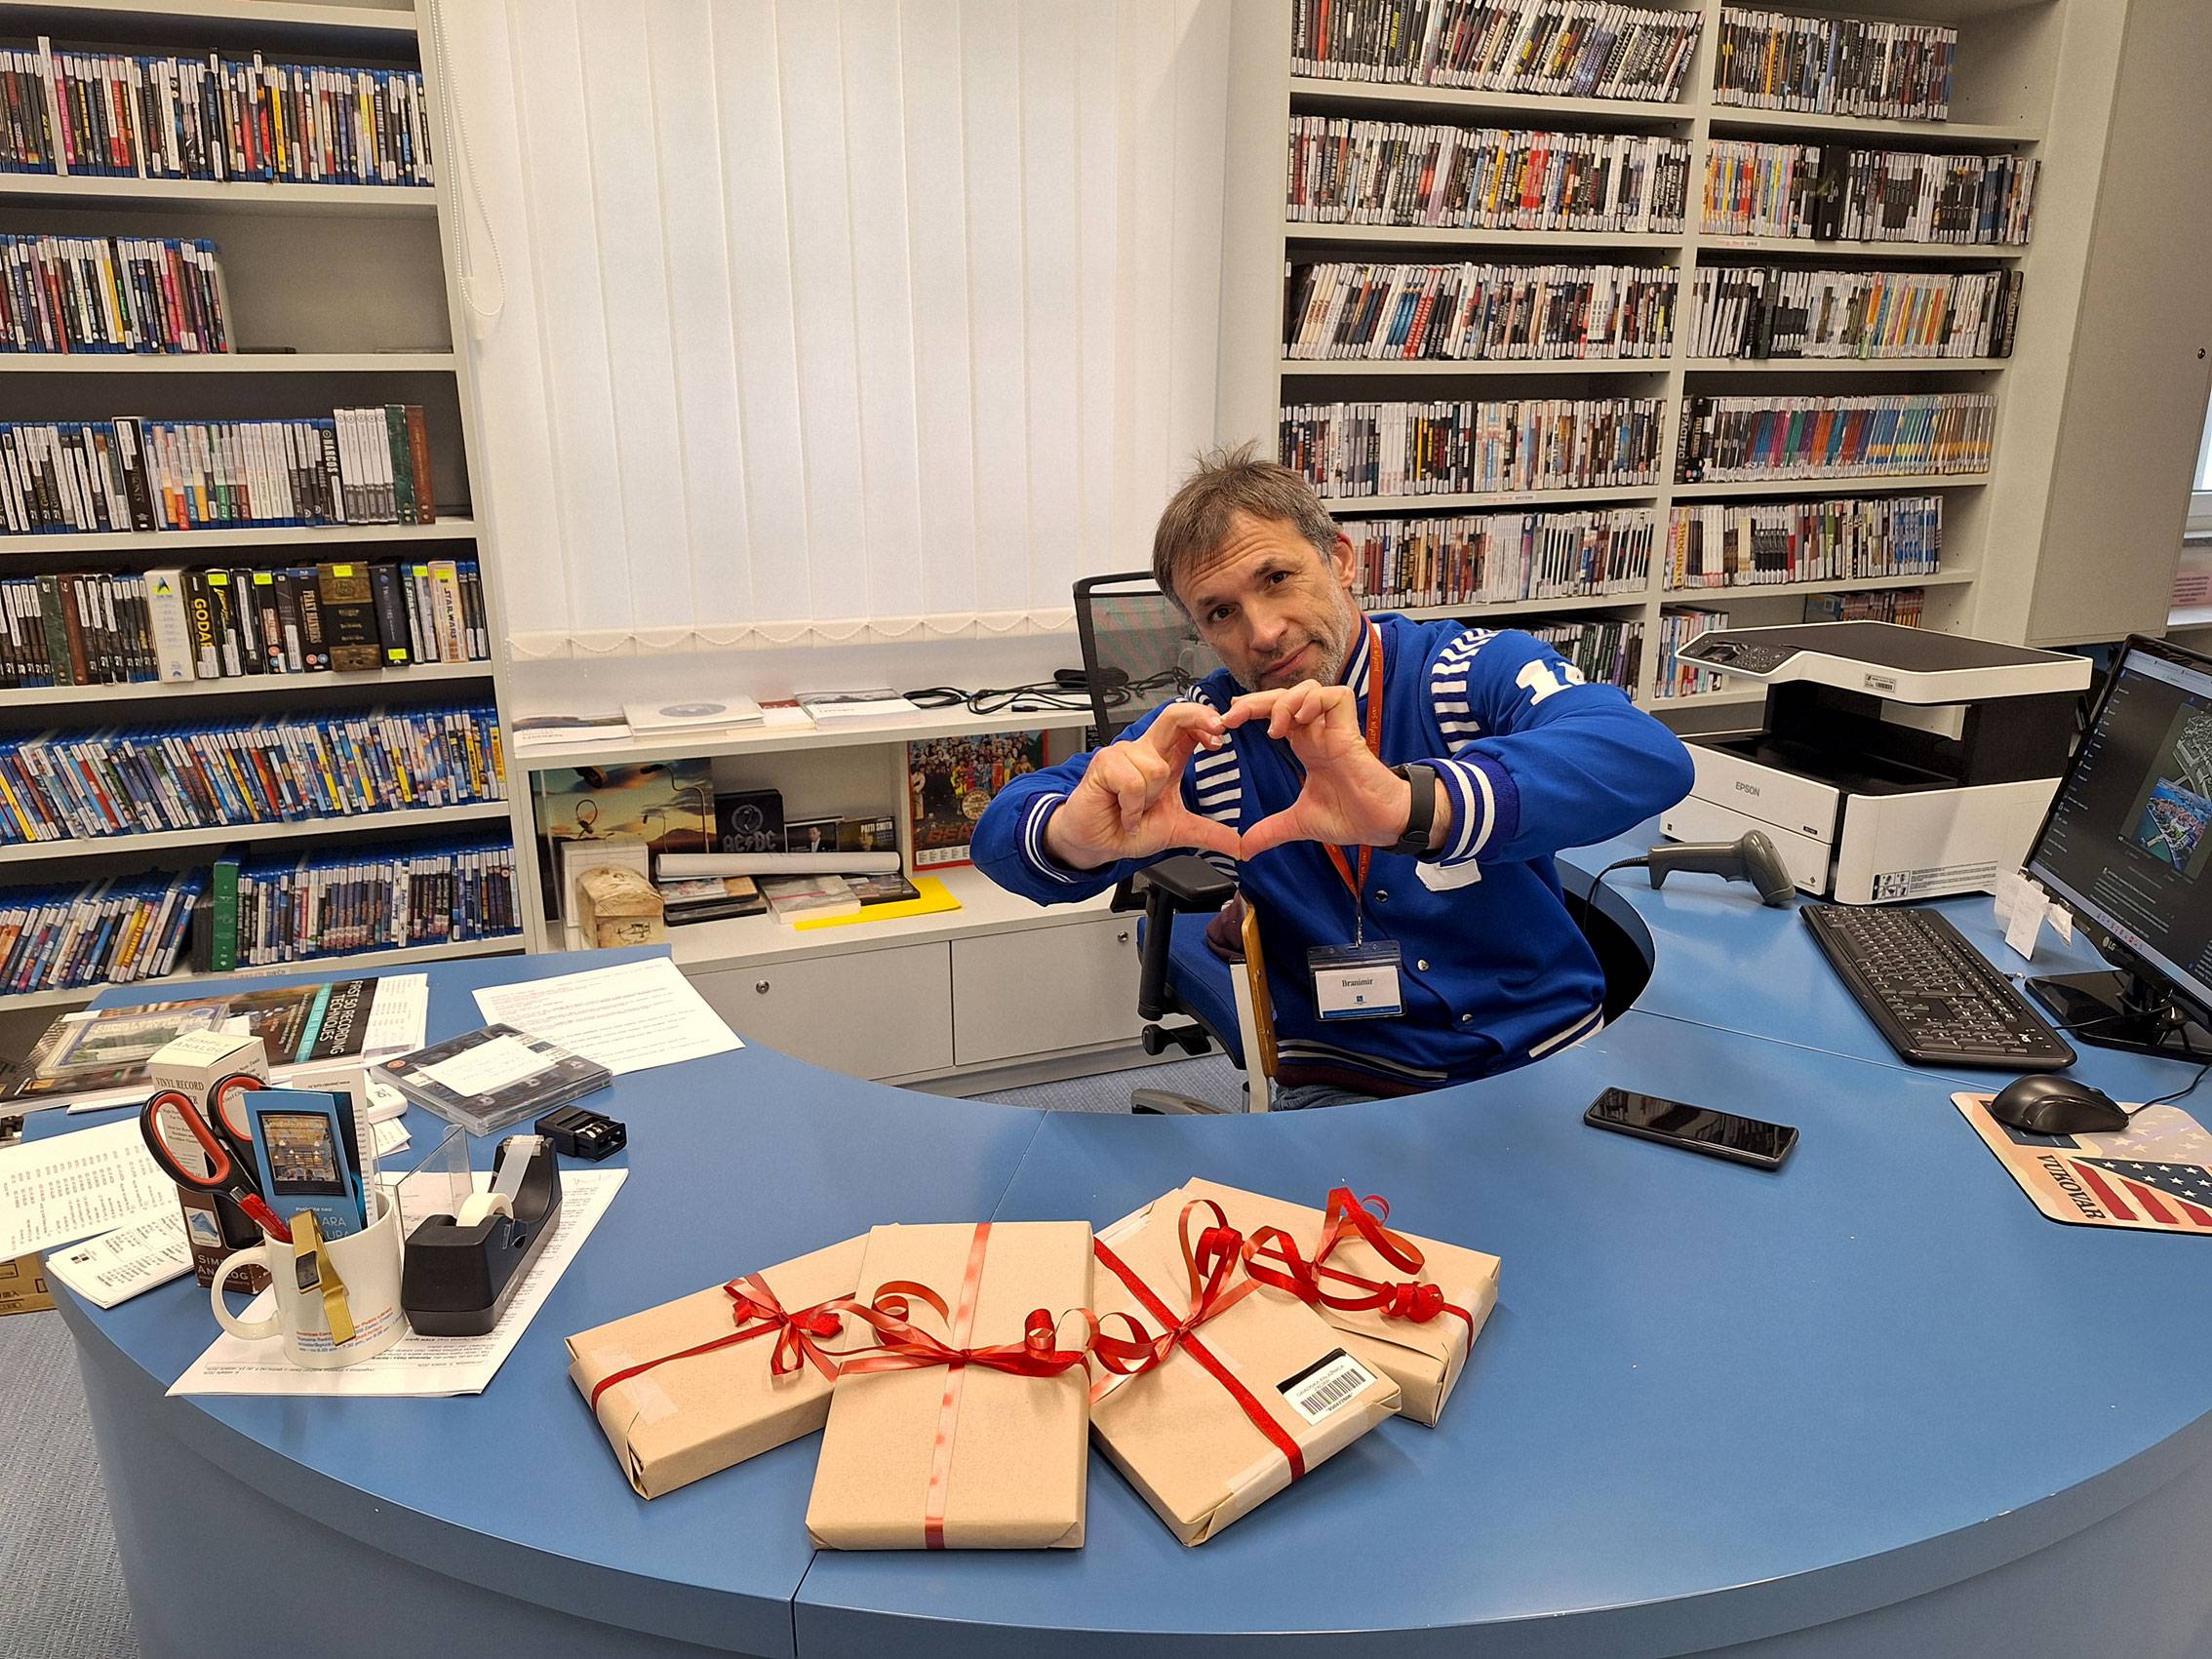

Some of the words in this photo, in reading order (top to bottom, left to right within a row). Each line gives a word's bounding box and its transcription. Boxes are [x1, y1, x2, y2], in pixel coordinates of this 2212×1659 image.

[323, 439, 338, 473] NARCOS
[1678, 523, 1688, 571] SHOGUN
[444, 588, 453, 612] STAR
[448, 613, 457, 639] WARS
[1736, 782, 1760, 796] EPSON
[350, 980, 363, 998] FIRST
[1342, 977, 1374, 988] Branimir
[320, 994, 345, 1042] TECHNIQUES
[331, 1009, 354, 1055] RECORDING
[156, 1078, 176, 1088] VINYL
[176, 1080, 204, 1091] RECORD
[2036, 1154, 2108, 1220] VUKOVAR
[198, 1266, 249, 1280] ANLOG
